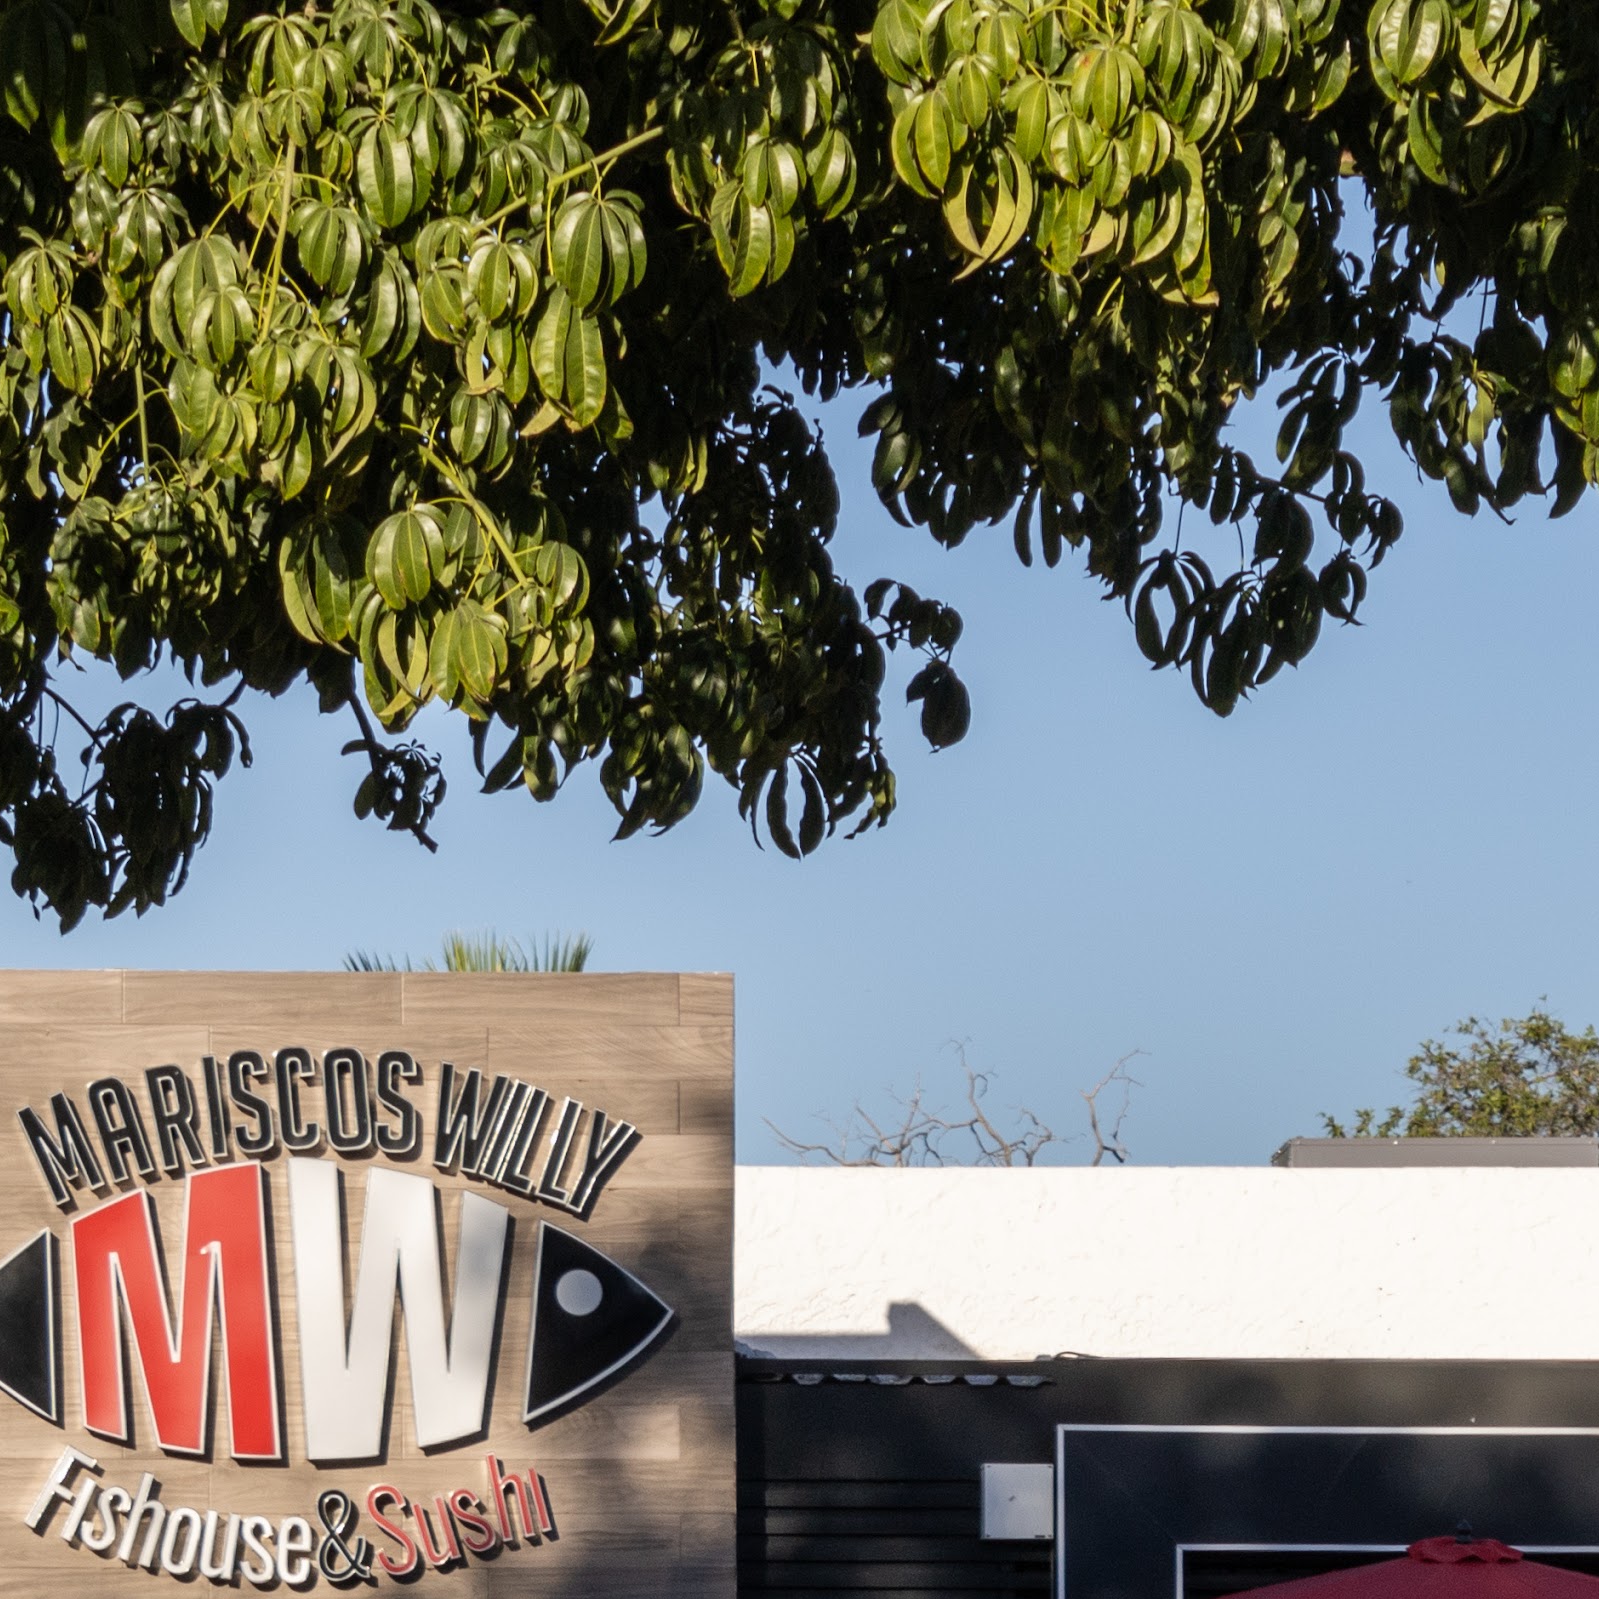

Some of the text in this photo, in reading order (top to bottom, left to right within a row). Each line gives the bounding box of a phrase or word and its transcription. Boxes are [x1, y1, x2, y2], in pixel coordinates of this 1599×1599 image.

[16, 1046, 638, 1214] MARISCOS WILLY
[70, 1156, 511, 1462] MW
[365, 1451, 555, 1576] Sushi
